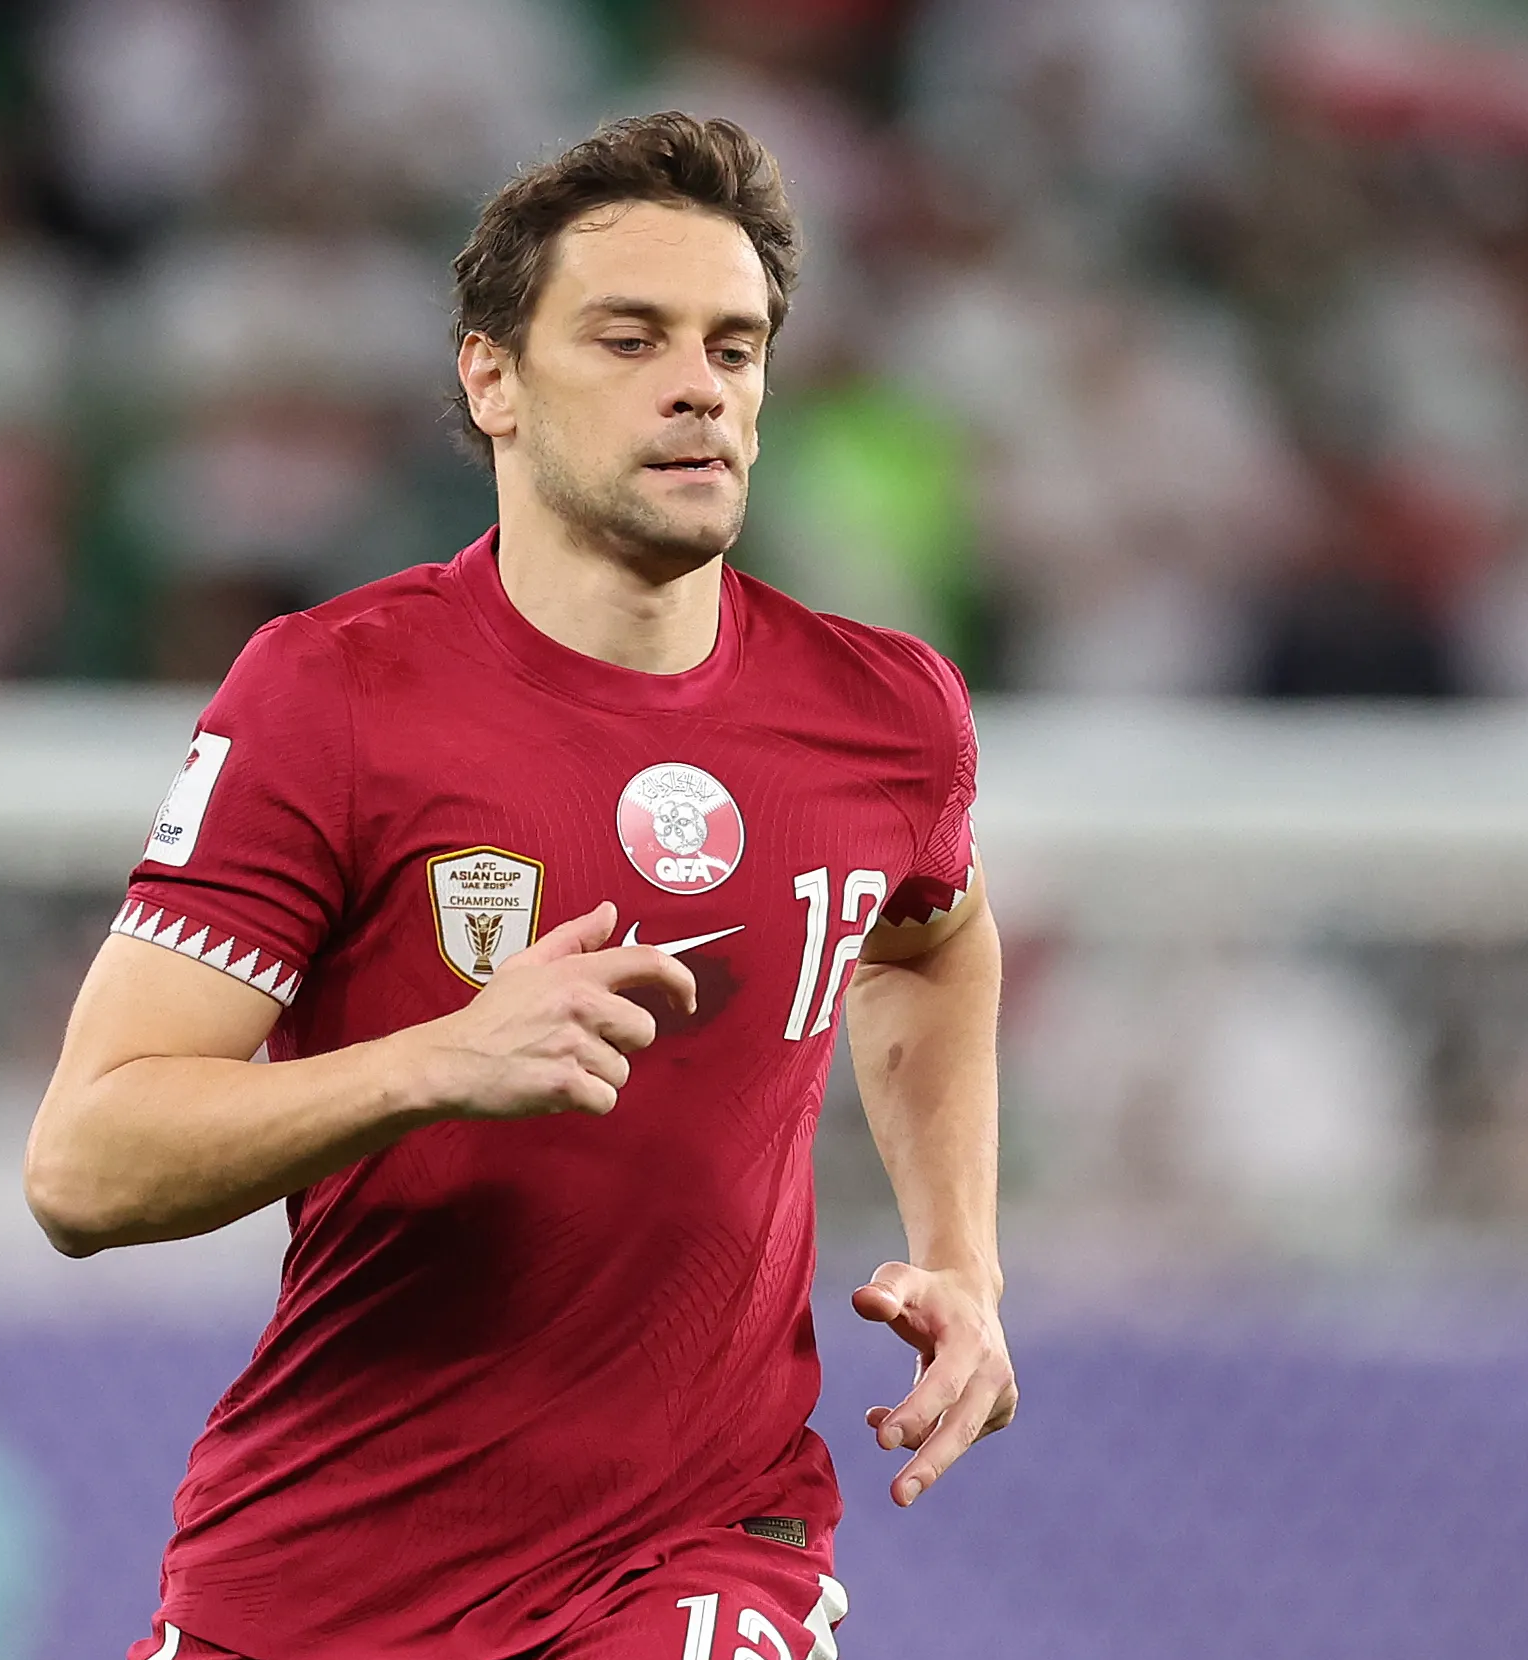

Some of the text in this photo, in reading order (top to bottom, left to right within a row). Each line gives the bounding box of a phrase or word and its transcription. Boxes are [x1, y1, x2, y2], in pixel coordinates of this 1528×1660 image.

[159, 823, 183, 836] CUP
[474, 862, 496, 871] AFC
[655, 856, 714, 883] QFA
[450, 870, 521, 882] ASIAN CUP
[461, 881, 481, 889] UAE
[449, 896, 520, 907] CHAMPIONS
[783, 866, 887, 1042] 12
